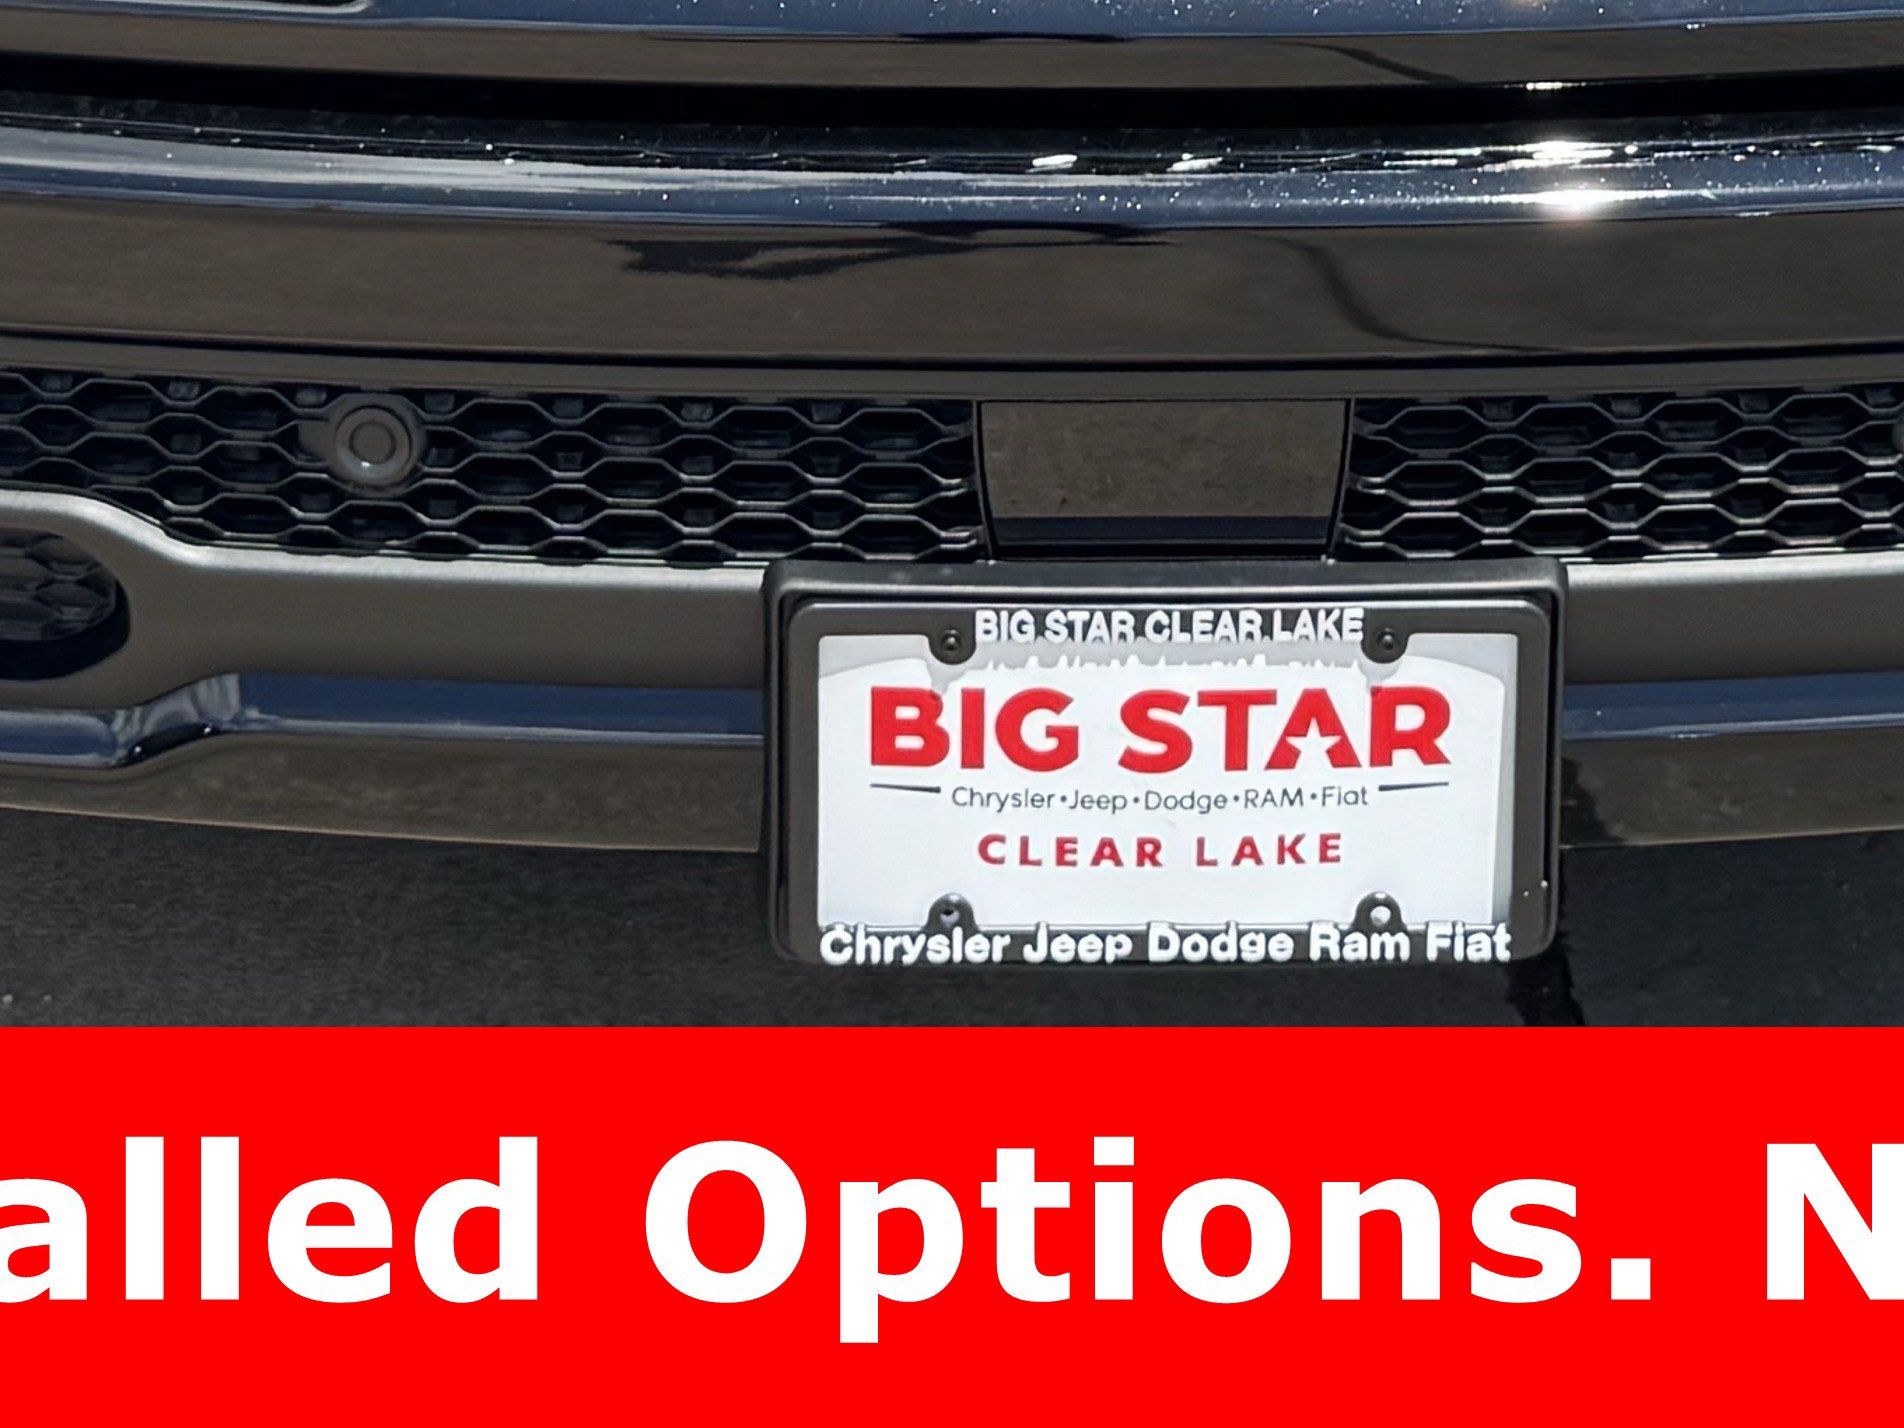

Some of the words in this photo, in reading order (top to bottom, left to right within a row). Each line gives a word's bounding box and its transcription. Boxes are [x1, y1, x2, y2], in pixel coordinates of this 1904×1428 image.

[976, 609, 1035, 644] BIG
[1044, 609, 1135, 644] STAR
[1144, 609, 1264, 644] CLEAR
[1273, 608, 1364, 644] LAKE
[870, 687, 1079, 772] BIG
[1118, 687, 1452, 773] STAR
[951, 786, 1055, 813] Chrysler
[1068, 790, 1129, 814] Jeep
[1144, 790, 1228, 815] Dodge
[1244, 787, 1304, 810] RAM
[977, 833, 1163, 867] CLEAR
[1196, 832, 1342, 867] LAKE
[820, 923, 1011, 966] Chrysler
[1022, 922, 1133, 965] Jeep
[1148, 921, 1294, 964] Dodge
[1309, 921, 1411, 962] Ram
[1426, 921, 1512, 963] Fiat
